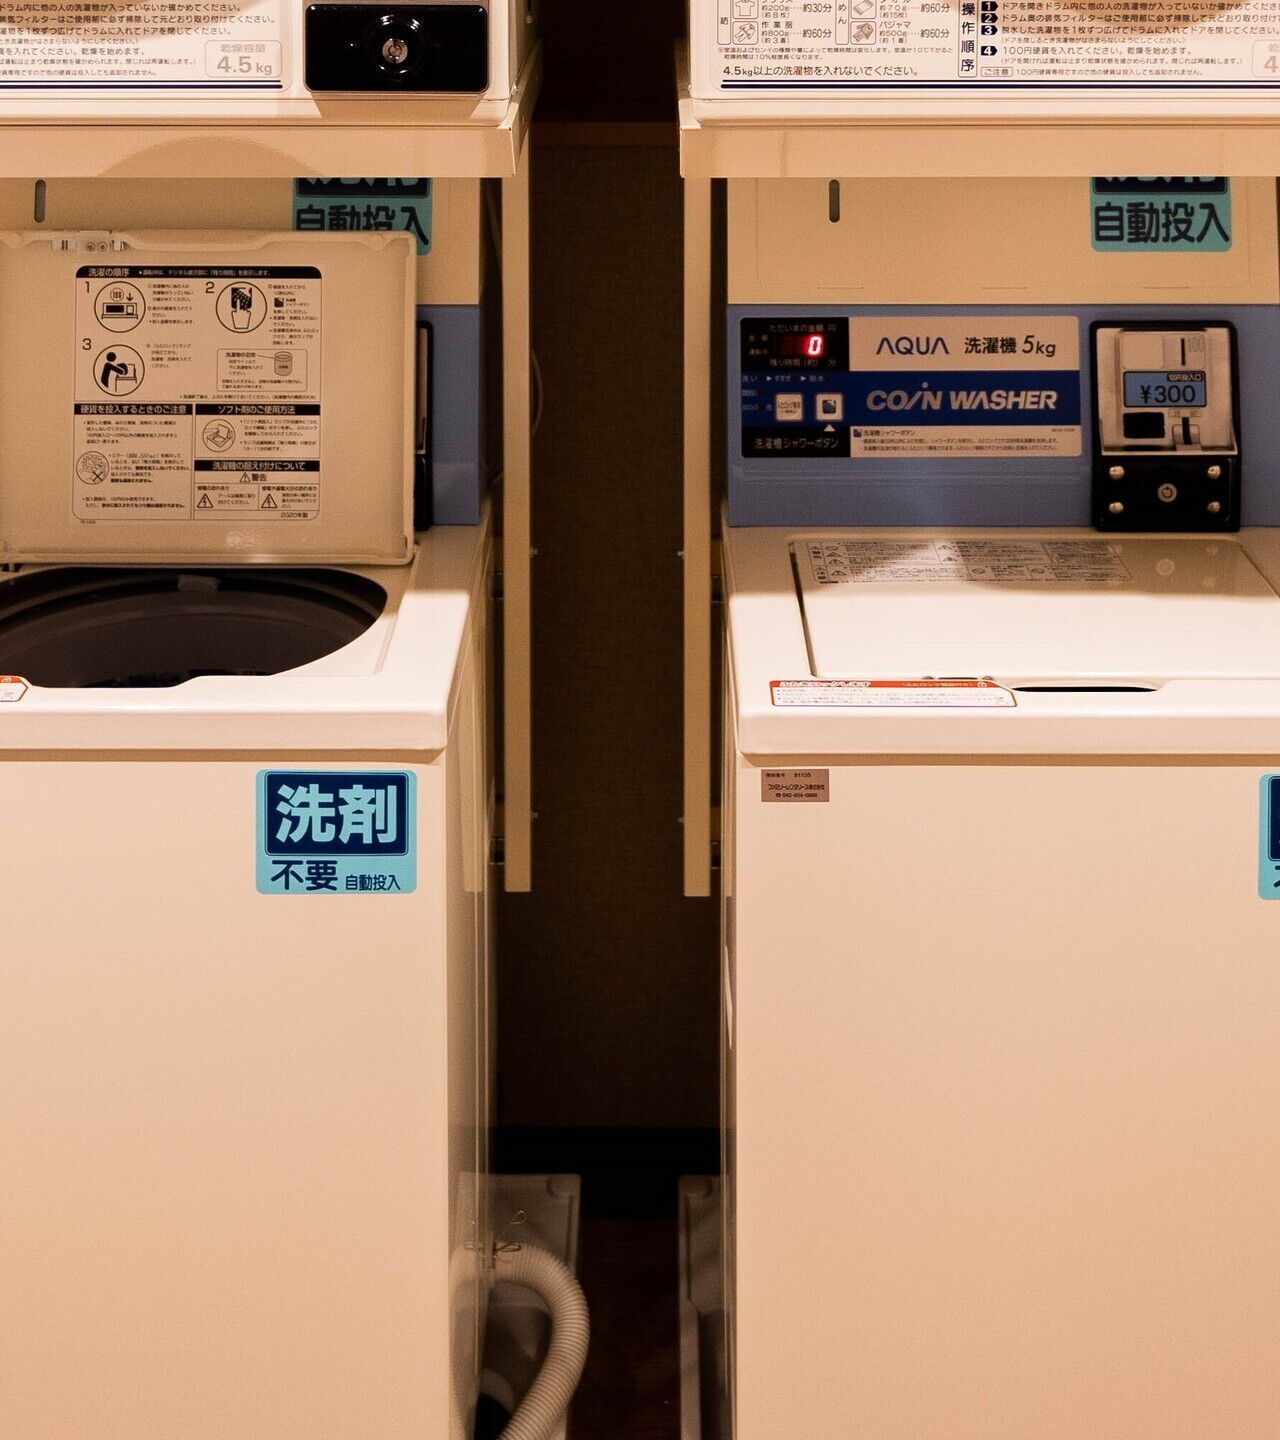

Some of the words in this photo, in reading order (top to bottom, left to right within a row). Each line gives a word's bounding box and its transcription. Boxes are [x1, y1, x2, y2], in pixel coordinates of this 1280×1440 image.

[961, 3, 975, 72] 操作順序
[217, 56, 252, 73] 4.5
[255, 61, 272, 76] kg
[296, 205, 429, 245] 自動投入
[1094, 202, 1230, 243] 自動投入
[205, 282, 215, 293] 2
[82, 338, 92, 350] 3
[808, 336, 823, 355] 0
[876, 337, 949, 355] AQUA
[965, 337, 1017, 354] 洗濯機
[1022, 336, 1056, 357] 5kg
[950, 391, 1057, 410] WASHER
[1140, 385, 1195, 403] ¥300
[276, 783, 398, 844] 洗剤
[271, 860, 338, 891] 不要
[345, 874, 401, 891] 自動投入
